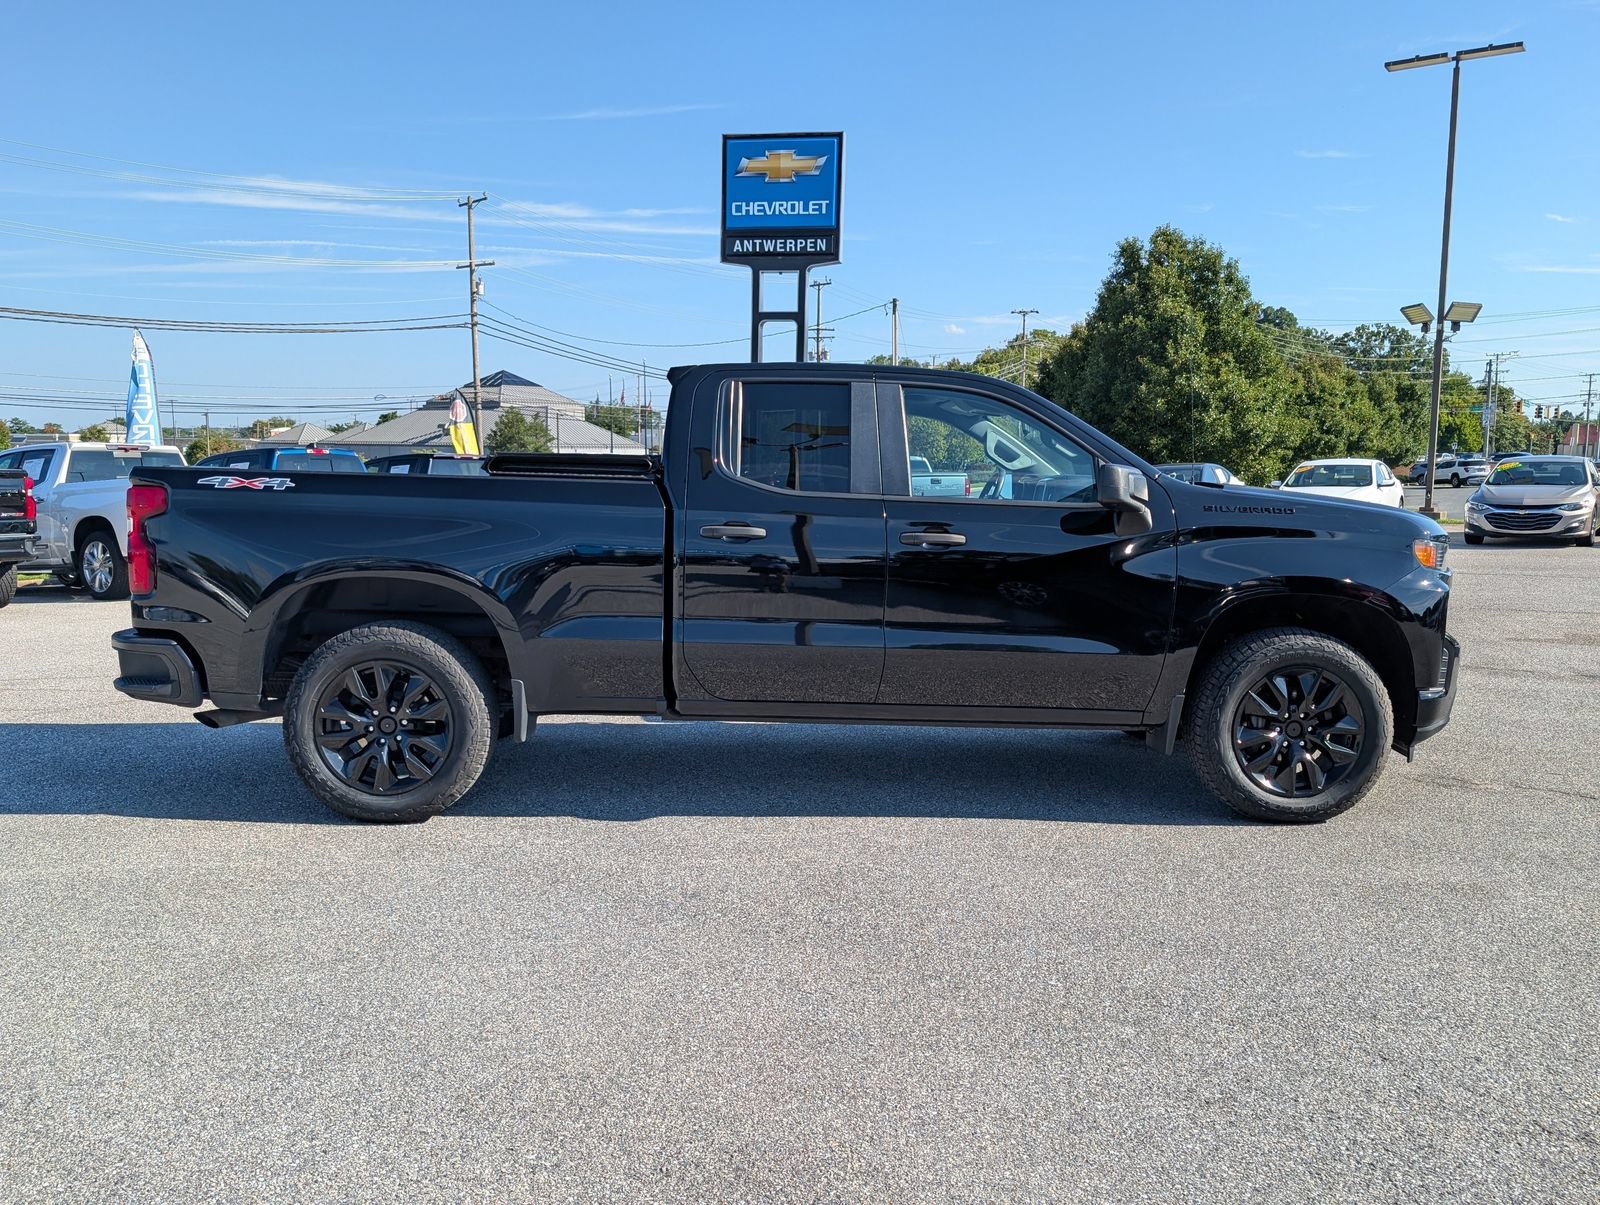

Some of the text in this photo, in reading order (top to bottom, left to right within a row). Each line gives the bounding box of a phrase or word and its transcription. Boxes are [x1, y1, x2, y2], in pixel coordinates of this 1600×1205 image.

[731, 200, 829, 215] CHEVROLET
[733, 239, 826, 252] ANTWERPEN
[1202, 504, 1296, 515] SILVERADO
